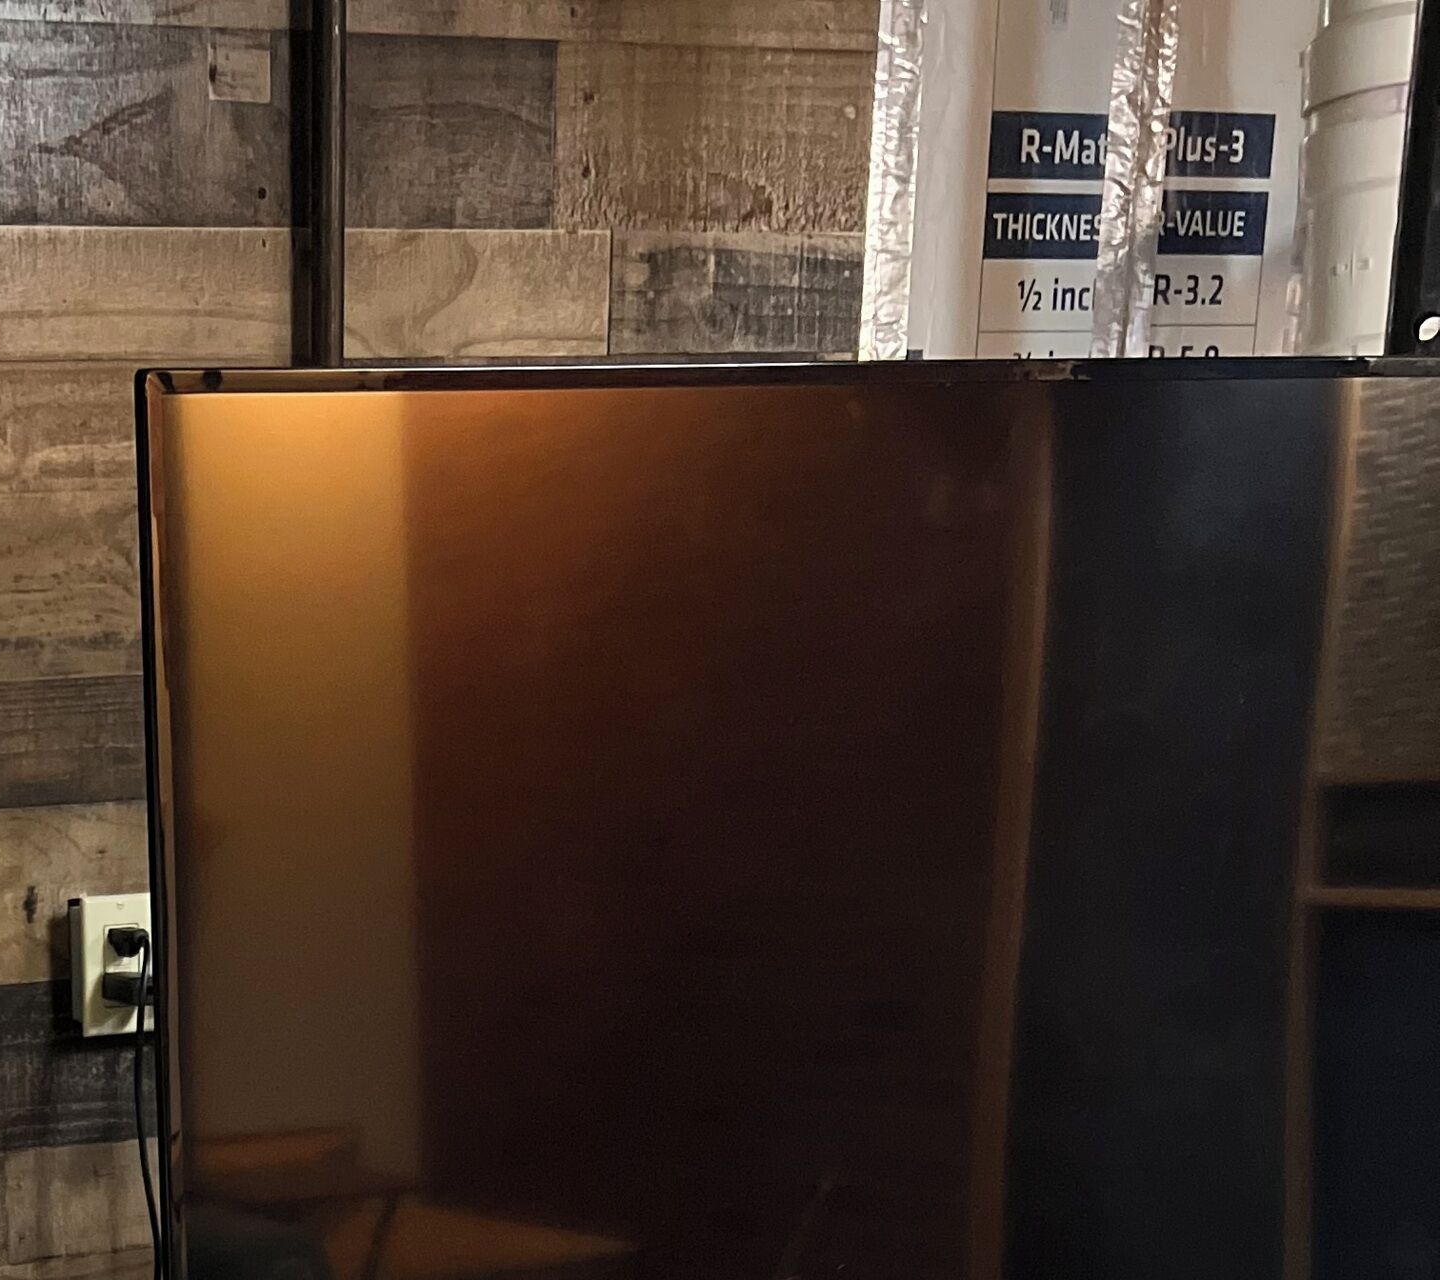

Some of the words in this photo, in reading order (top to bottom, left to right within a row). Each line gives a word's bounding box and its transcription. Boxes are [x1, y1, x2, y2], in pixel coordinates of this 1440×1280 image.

[1020, 129, 1108, 166] R-Mat
[1163, 126, 1245, 164] Plus-3
[993, 212, 1101, 241] THICKNES
[1052, 278, 1096, 311] inc
[1152, 274, 1224, 306] R-3.2
